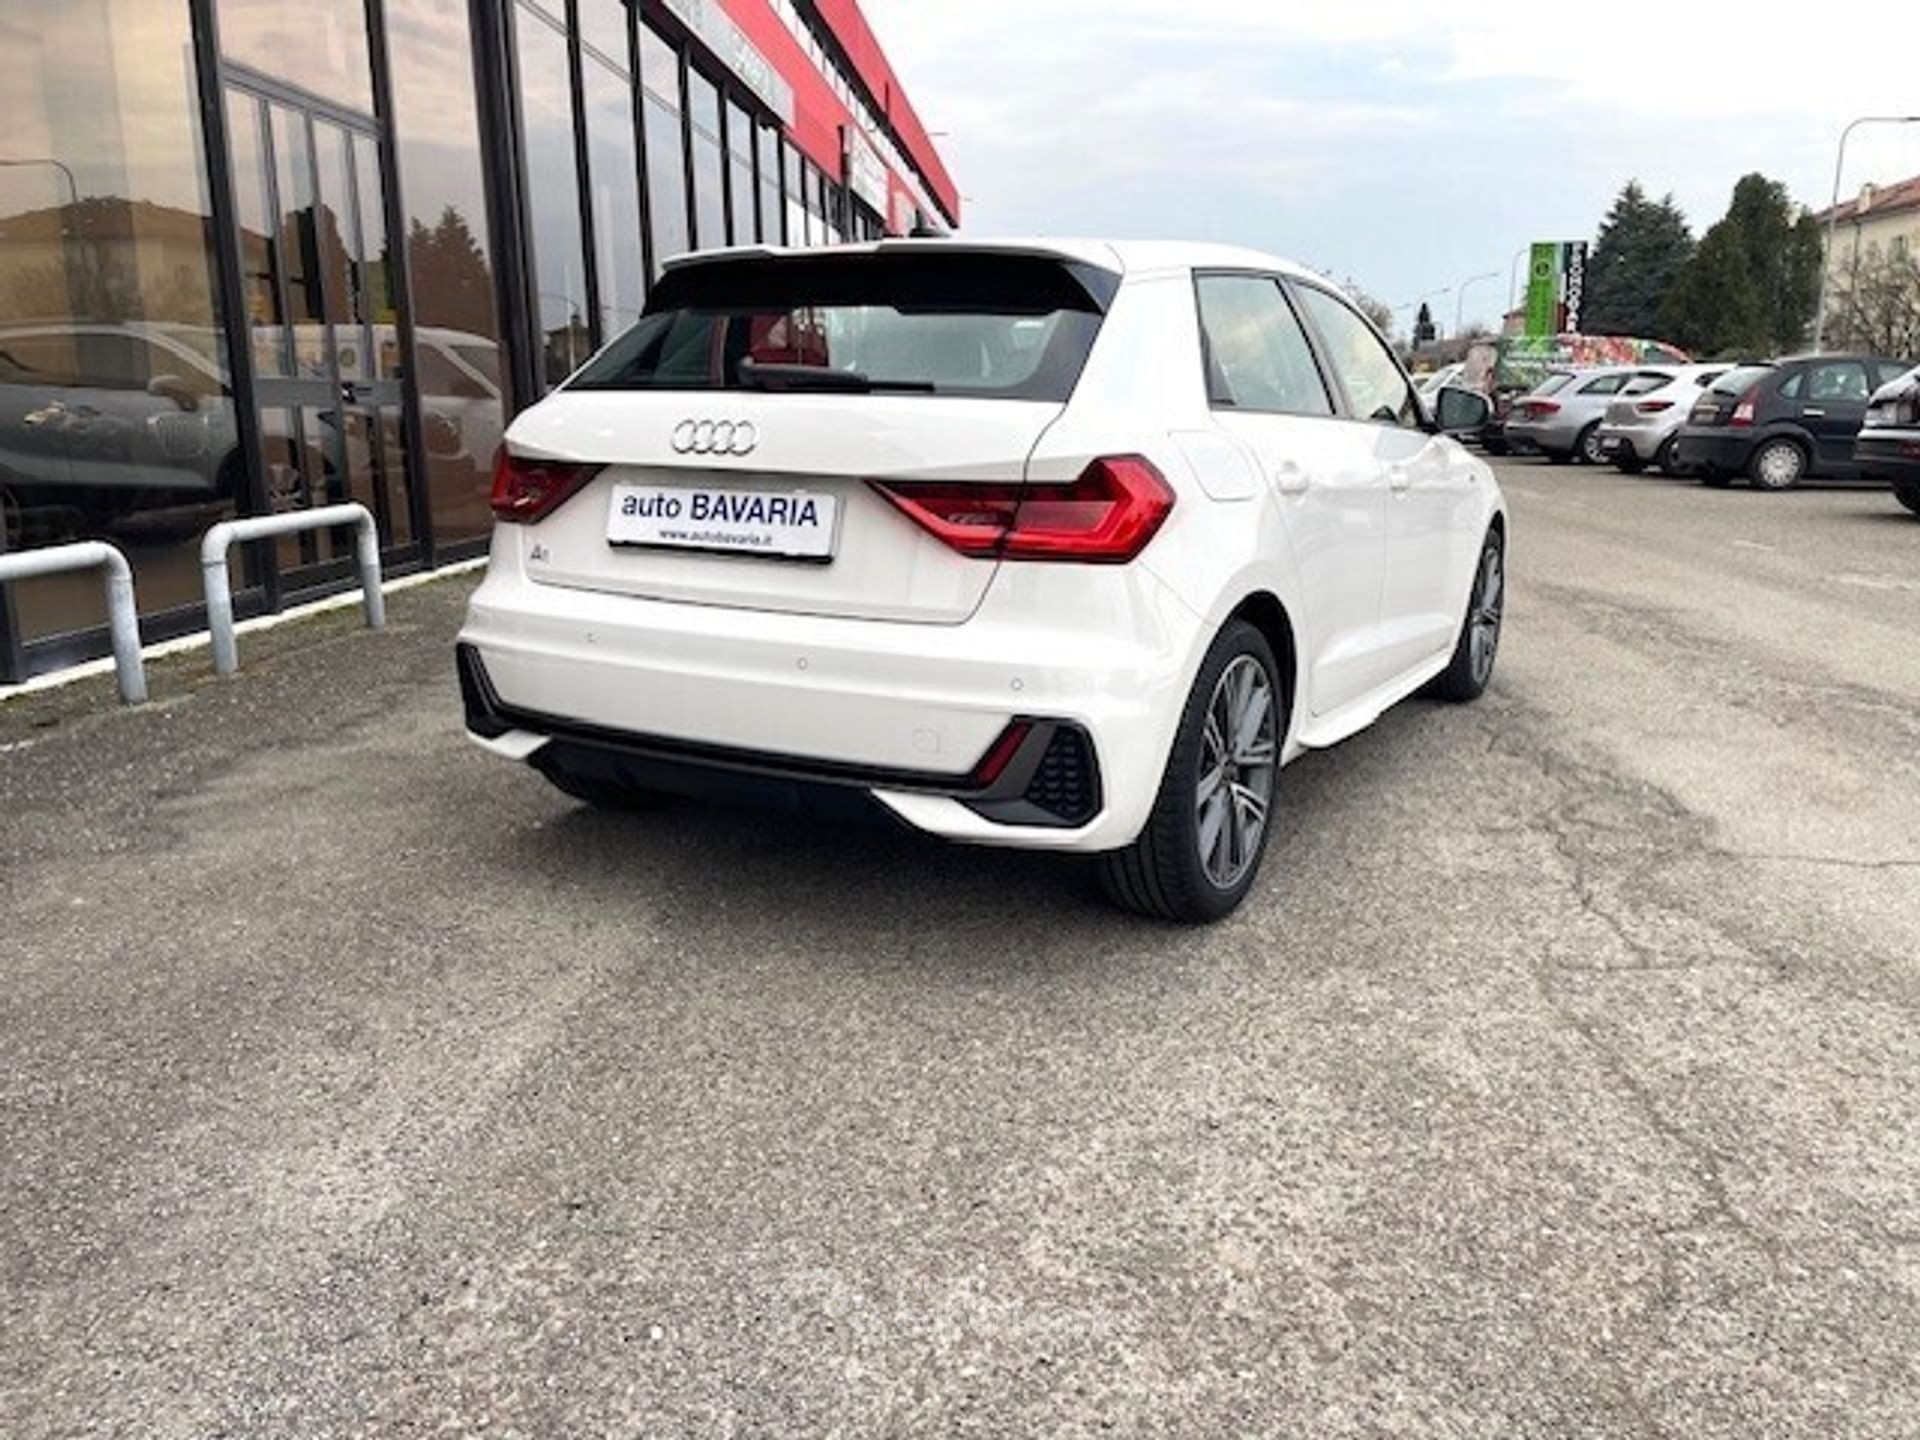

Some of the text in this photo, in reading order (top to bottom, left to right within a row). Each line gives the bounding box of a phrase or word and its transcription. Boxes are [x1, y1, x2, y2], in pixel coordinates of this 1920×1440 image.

[622, 494, 818, 526] auto BAVARIA
[659, 530, 772, 546] www.autobavaria.it
